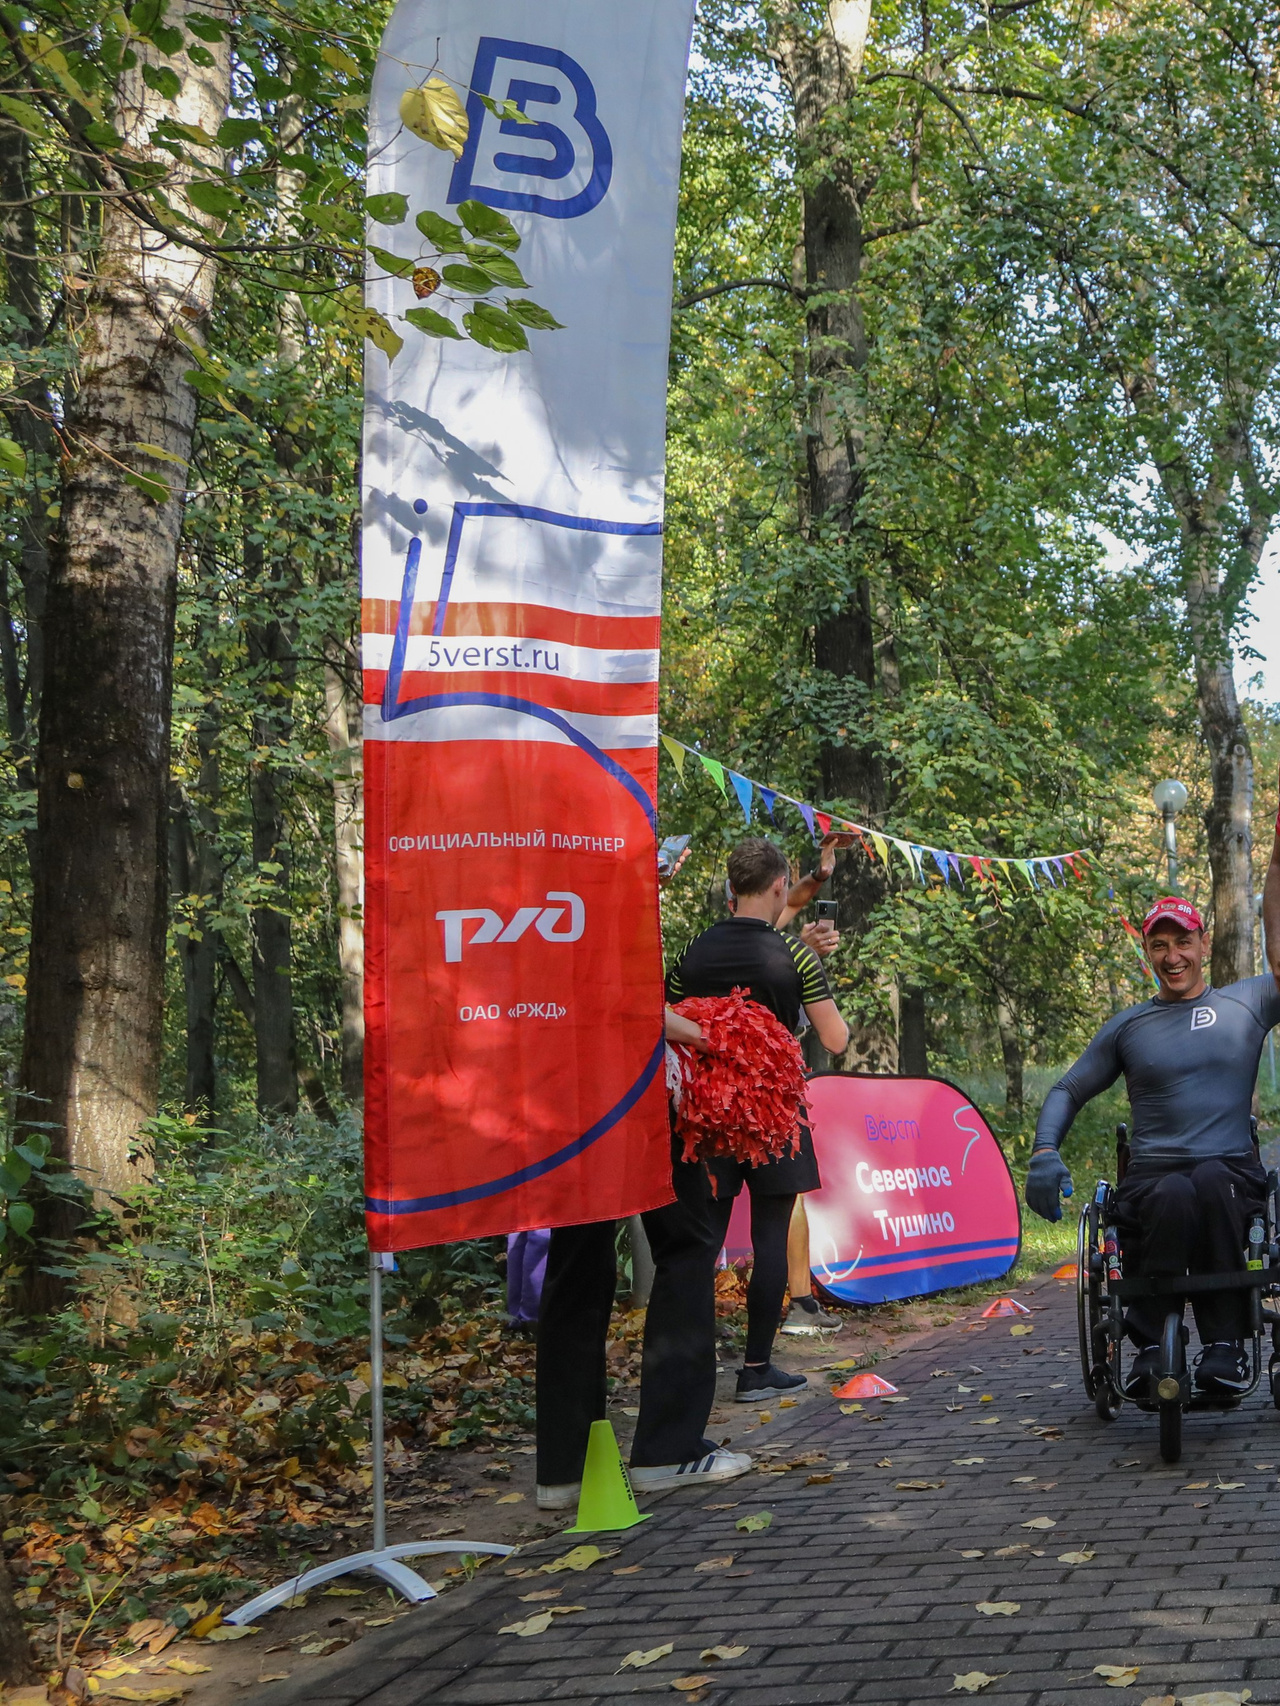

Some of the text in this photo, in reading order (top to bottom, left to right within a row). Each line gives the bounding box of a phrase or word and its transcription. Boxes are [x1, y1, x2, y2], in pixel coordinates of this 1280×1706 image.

[428, 641, 560, 671] 5verst.ru
[389, 829, 625, 852] ОФИЦИАЛЬНЫЙ ПАРТНЕР
[459, 1002, 567, 1022] ОАО «РЖД»
[855, 1161, 952, 1196] Северное
[873, 1209, 955, 1247] Тушино
